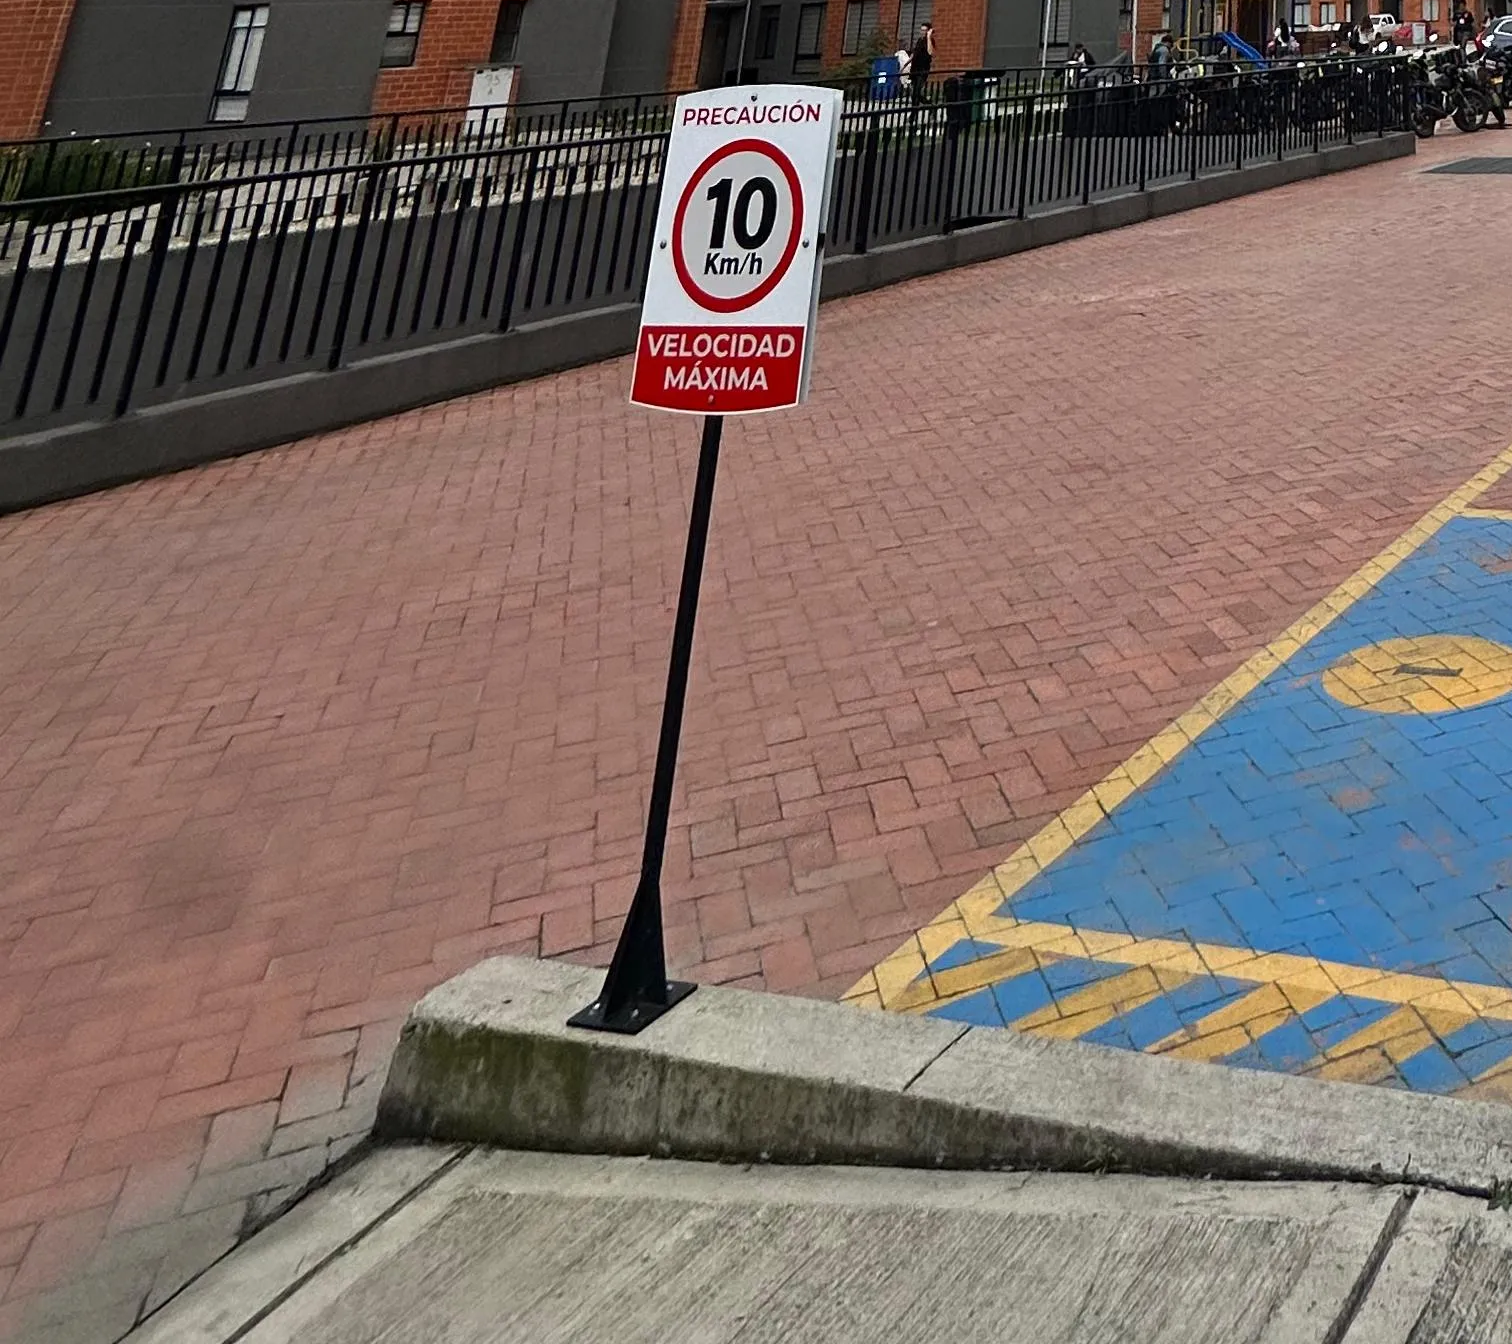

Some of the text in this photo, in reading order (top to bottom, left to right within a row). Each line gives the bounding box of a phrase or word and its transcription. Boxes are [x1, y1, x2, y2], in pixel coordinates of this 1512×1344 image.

[683, 99, 821, 126] PRECAUCIÓN
[706, 176, 777, 249] 10
[704, 252, 763, 275] Km/h
[648, 333, 795, 358] VELOCIDAD
[664, 360, 768, 391] MÁXIMA
